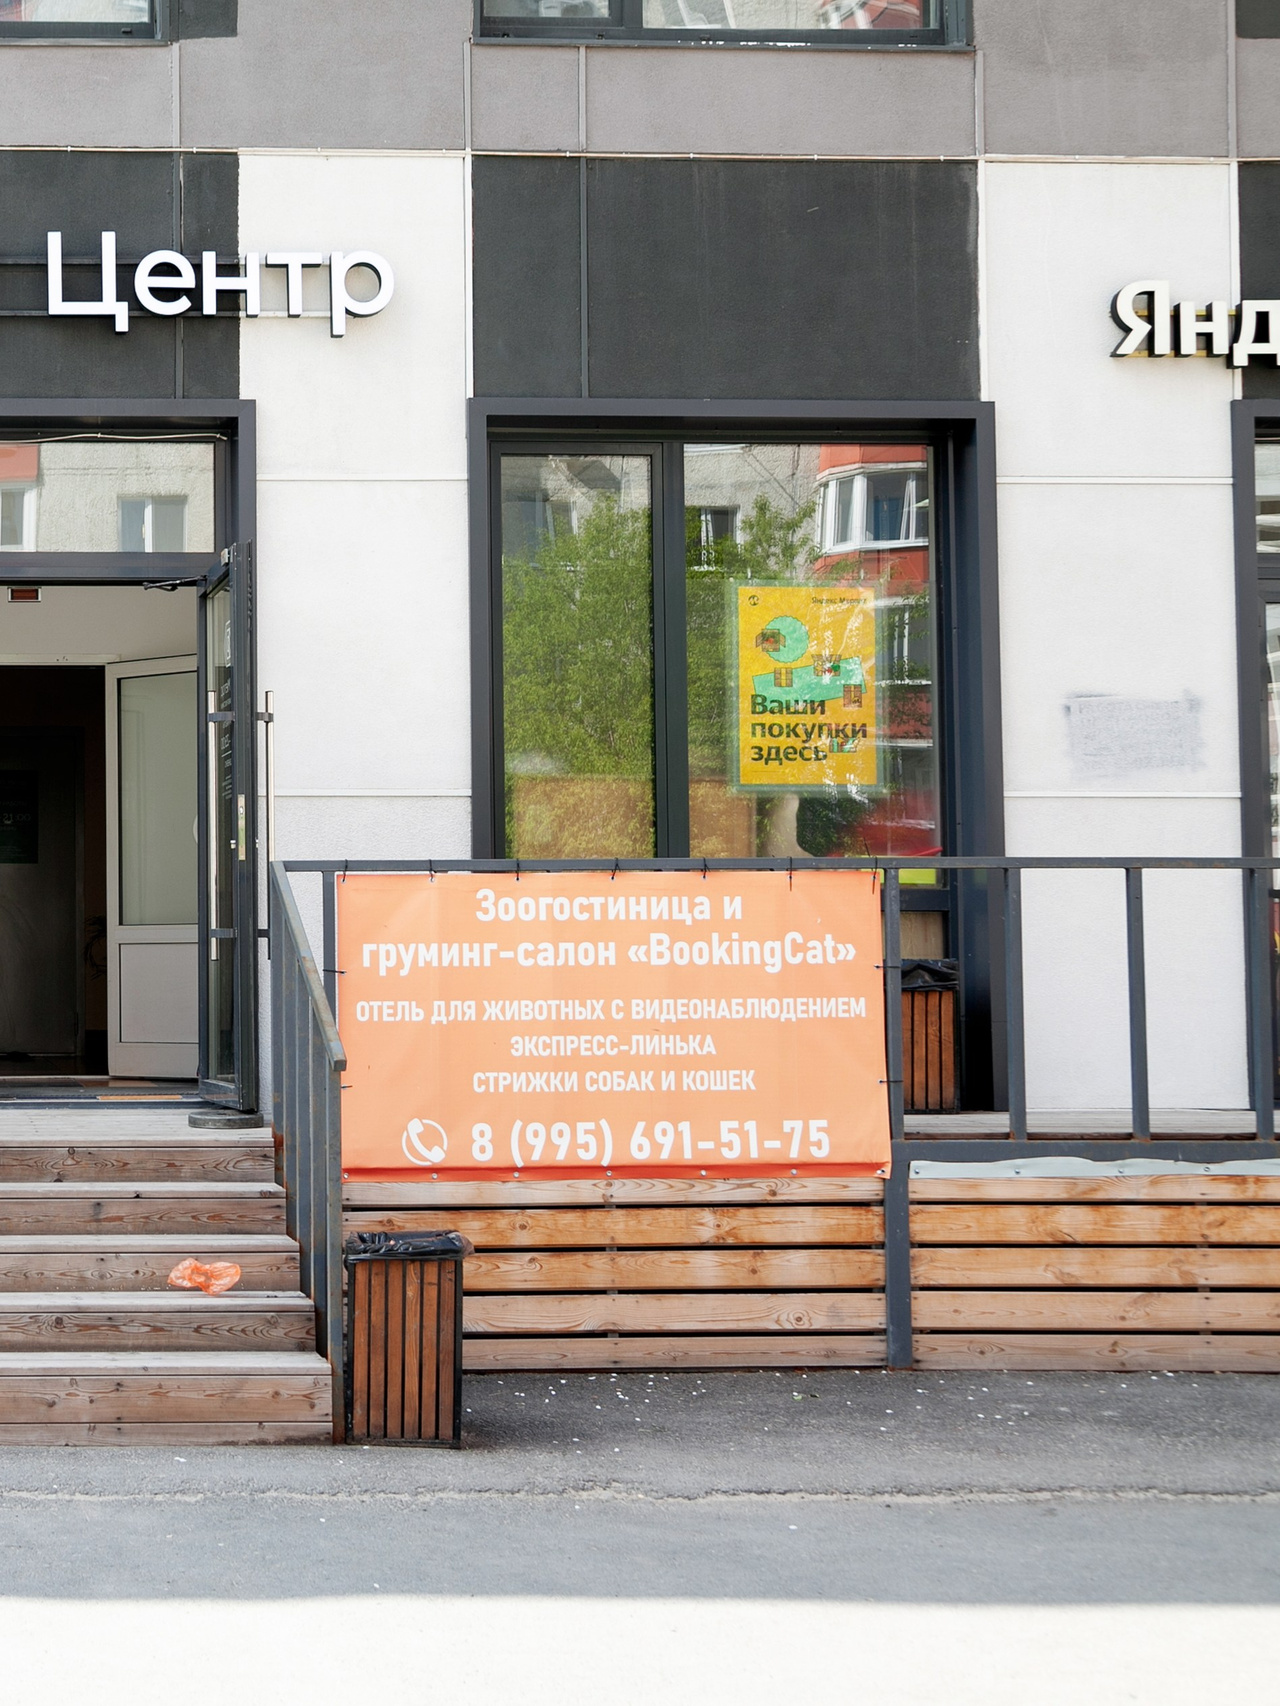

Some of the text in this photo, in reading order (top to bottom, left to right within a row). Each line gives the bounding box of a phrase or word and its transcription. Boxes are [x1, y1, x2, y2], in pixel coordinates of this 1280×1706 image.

[47, 231, 395, 338] Центр
[750, 693, 826, 716] Ваши
[750, 721, 867, 743] покупки
[750, 744, 828, 766] здесь
[475, 887, 743, 926] Зоогостиница и
[362, 930, 857, 976] груминг-салон «BookingCat»
[355, 996, 867, 1025] ОТЕЛЬ ДЛЯ ЖИВОТНЫХ С ВИДЕОНАБЛЮДЕНИЕМ
[510, 1033, 717, 1058] ЭКСПРЕСС-ЛИНЬКА
[472, 1069, 757, 1094] СТРИЖКИ СОБАК И КОШЕК
[472, 1117, 831, 1168] 8 (995) 691-51-75
